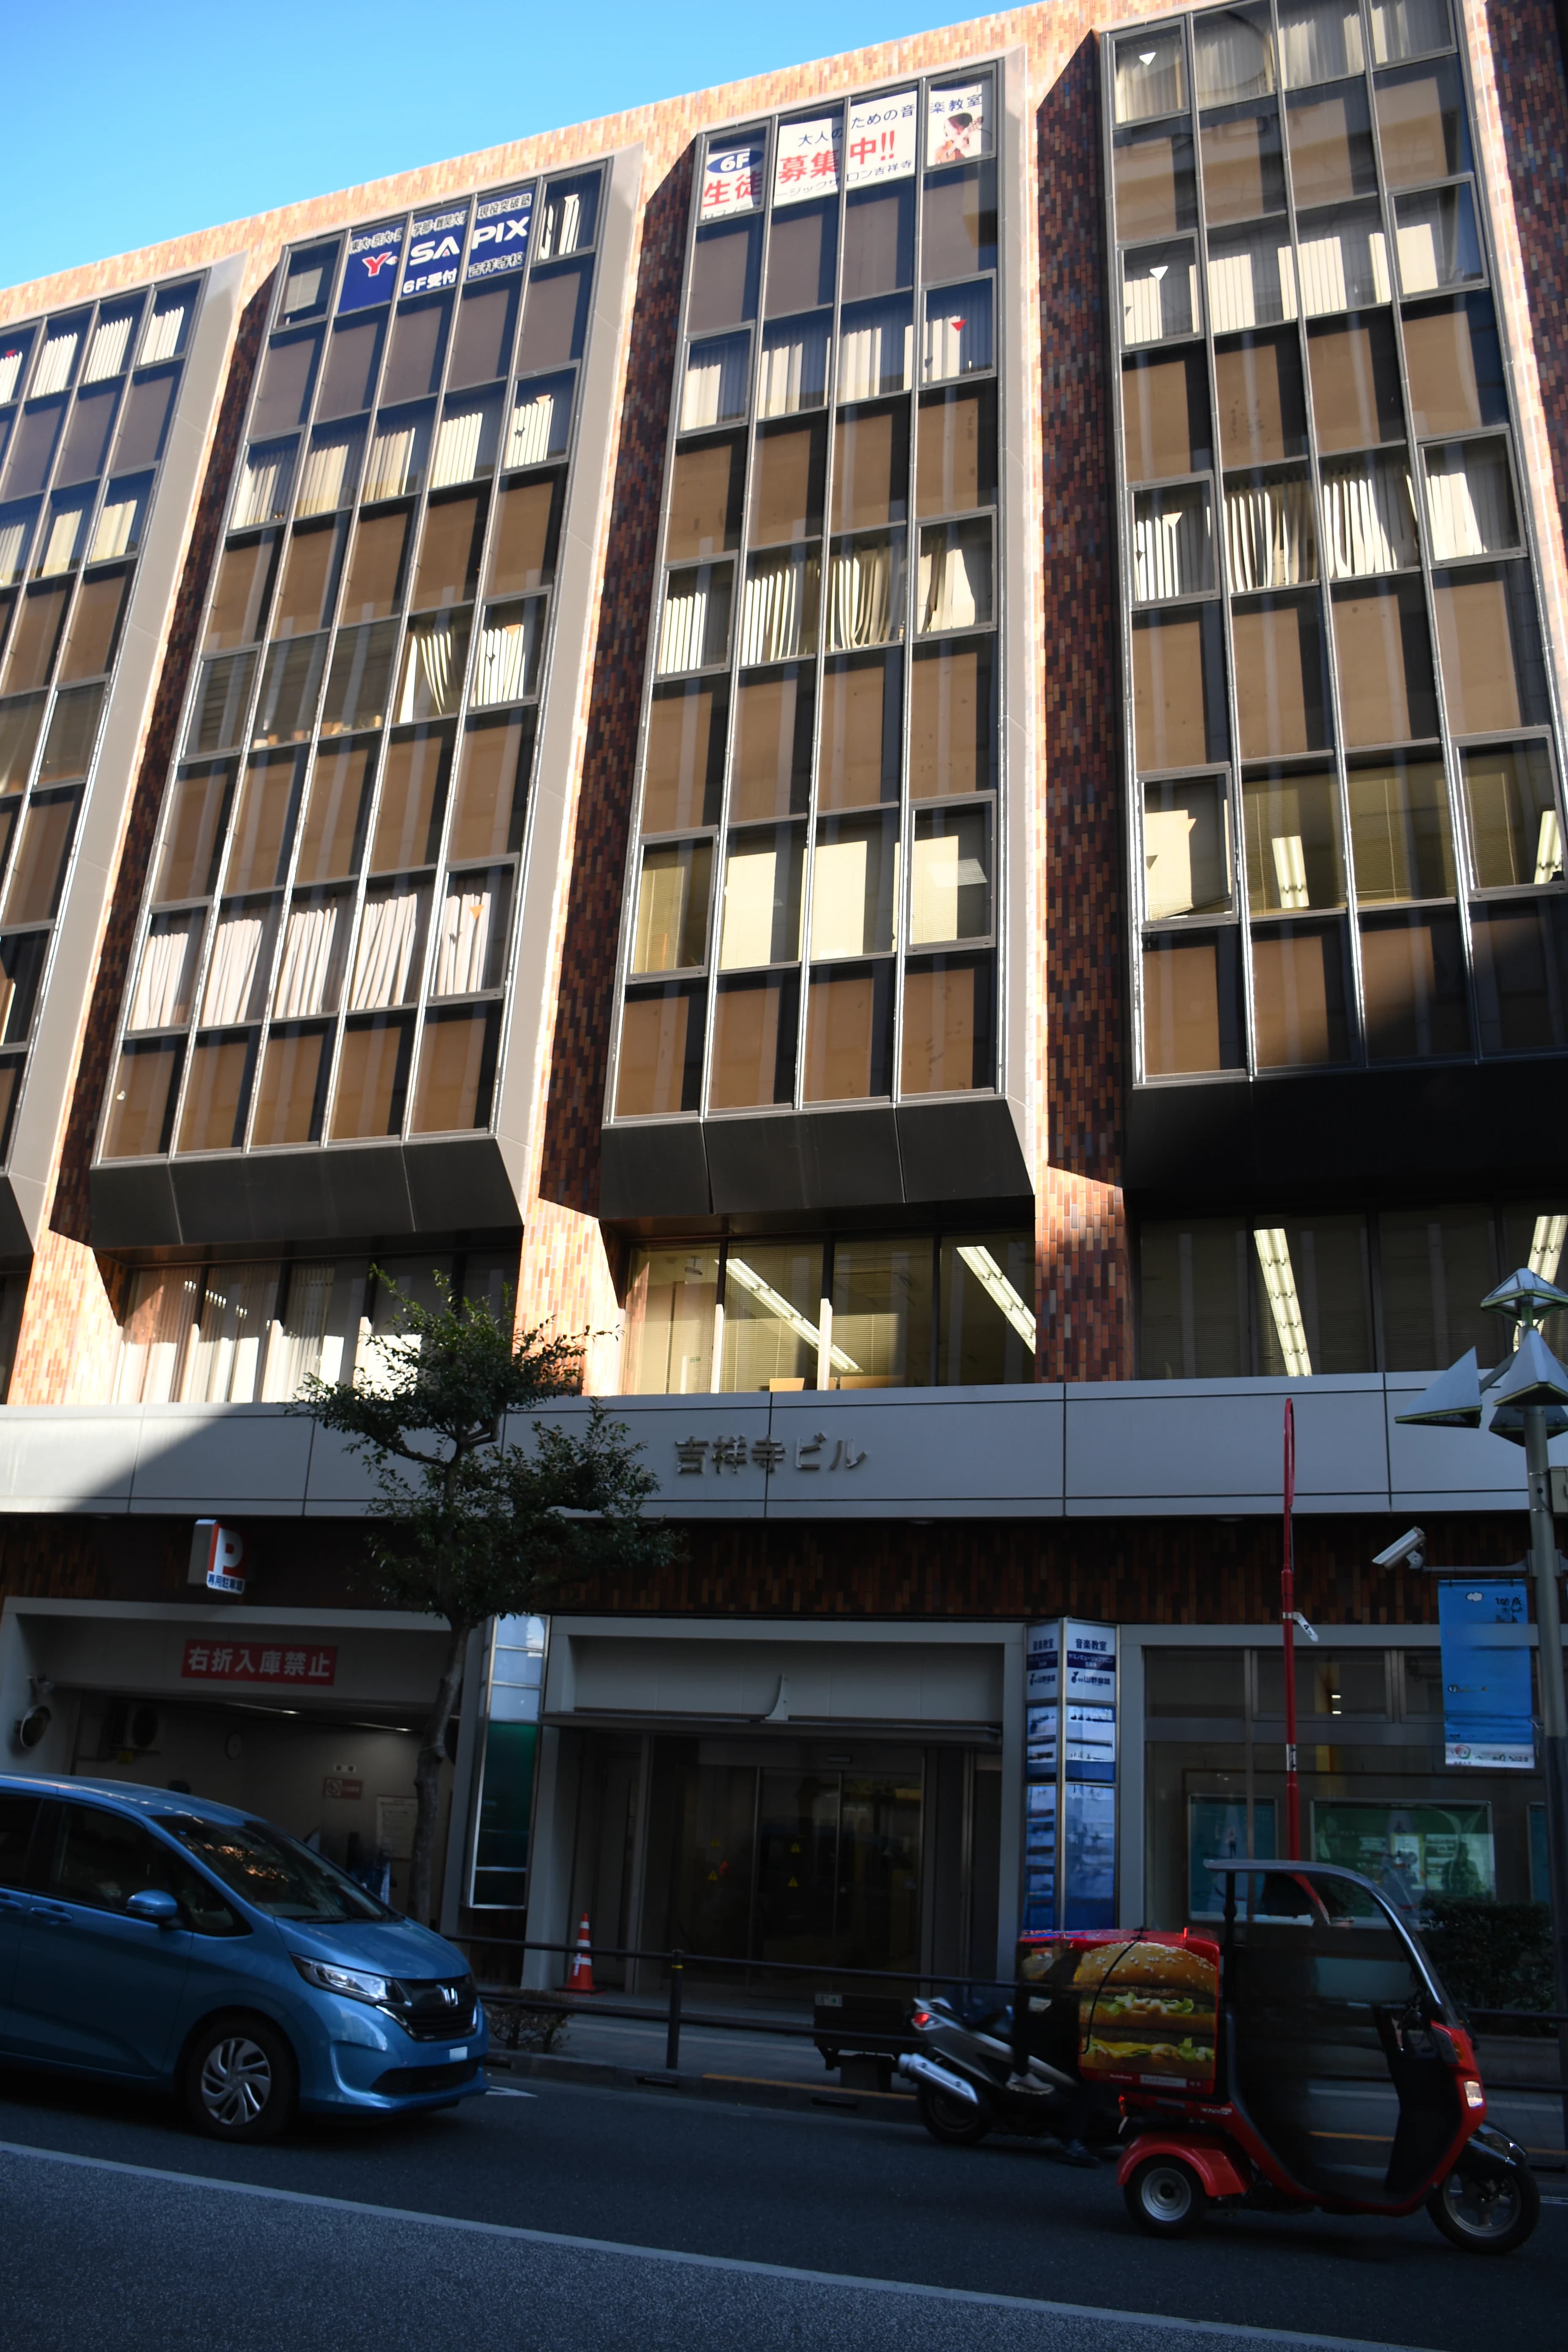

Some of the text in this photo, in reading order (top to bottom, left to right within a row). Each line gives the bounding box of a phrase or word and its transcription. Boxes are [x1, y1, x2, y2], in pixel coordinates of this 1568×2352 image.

[720, 152, 750, 172] 6F
[675, 1432, 868, 1474] 吉祥寺ビル
[214, 1527, 243, 1575] P
[1076, 1639, 1107, 1651] 音楽教室
[188, 1646, 330, 1677] 右折入庫禁止
